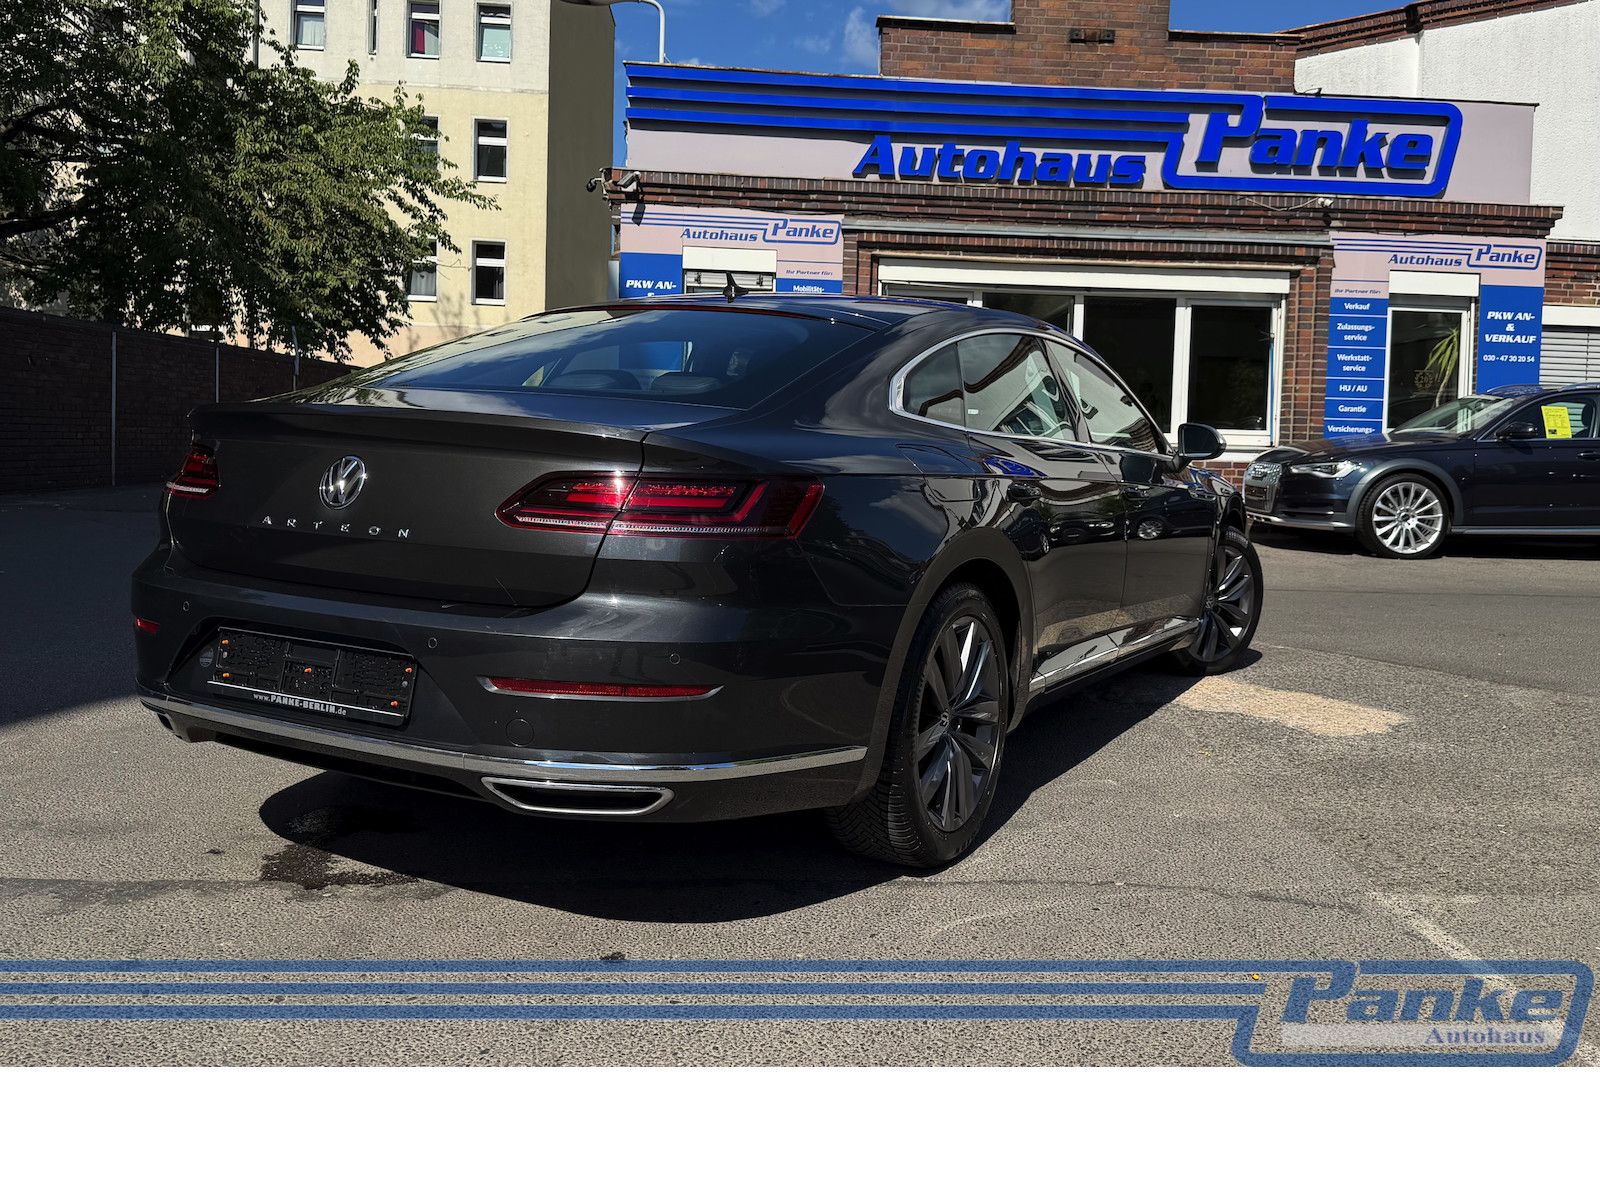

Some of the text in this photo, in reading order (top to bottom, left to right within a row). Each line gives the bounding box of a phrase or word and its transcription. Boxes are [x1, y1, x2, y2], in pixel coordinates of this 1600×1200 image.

[852, 108, 1434, 188] Autohaus Panke
[680, 219, 834, 242] Autohaus Panke
[1388, 245, 1536, 268] Autohaus Panke
[625, 279, 677, 290] PKW AN-
[792, 284, 825, 293] Mobilitäts-
[1486, 311, 1536, 321] PKW AN-
[1336, 322, 1375, 332] Zulassungs-
[1505, 323, 1515, 331] &
[1484, 334, 1537, 344] VERKAUF
[1337, 353, 1373, 362] Werkstatt-
[1483, 354, 1496, 362] 030
[1526, 355, 1535, 363] 54
[1342, 364, 1366, 372] service
[1339, 384, 1352, 392] HU
[1356, 384, 1368, 392] AU
[1338, 404, 1367, 413] Garantie
[1327, 425, 1376, 434] Versicherungs-
[262, 515, 410, 539] ARTEON
[253, 692, 347, 716] www.PANKE-BERLIN.de
